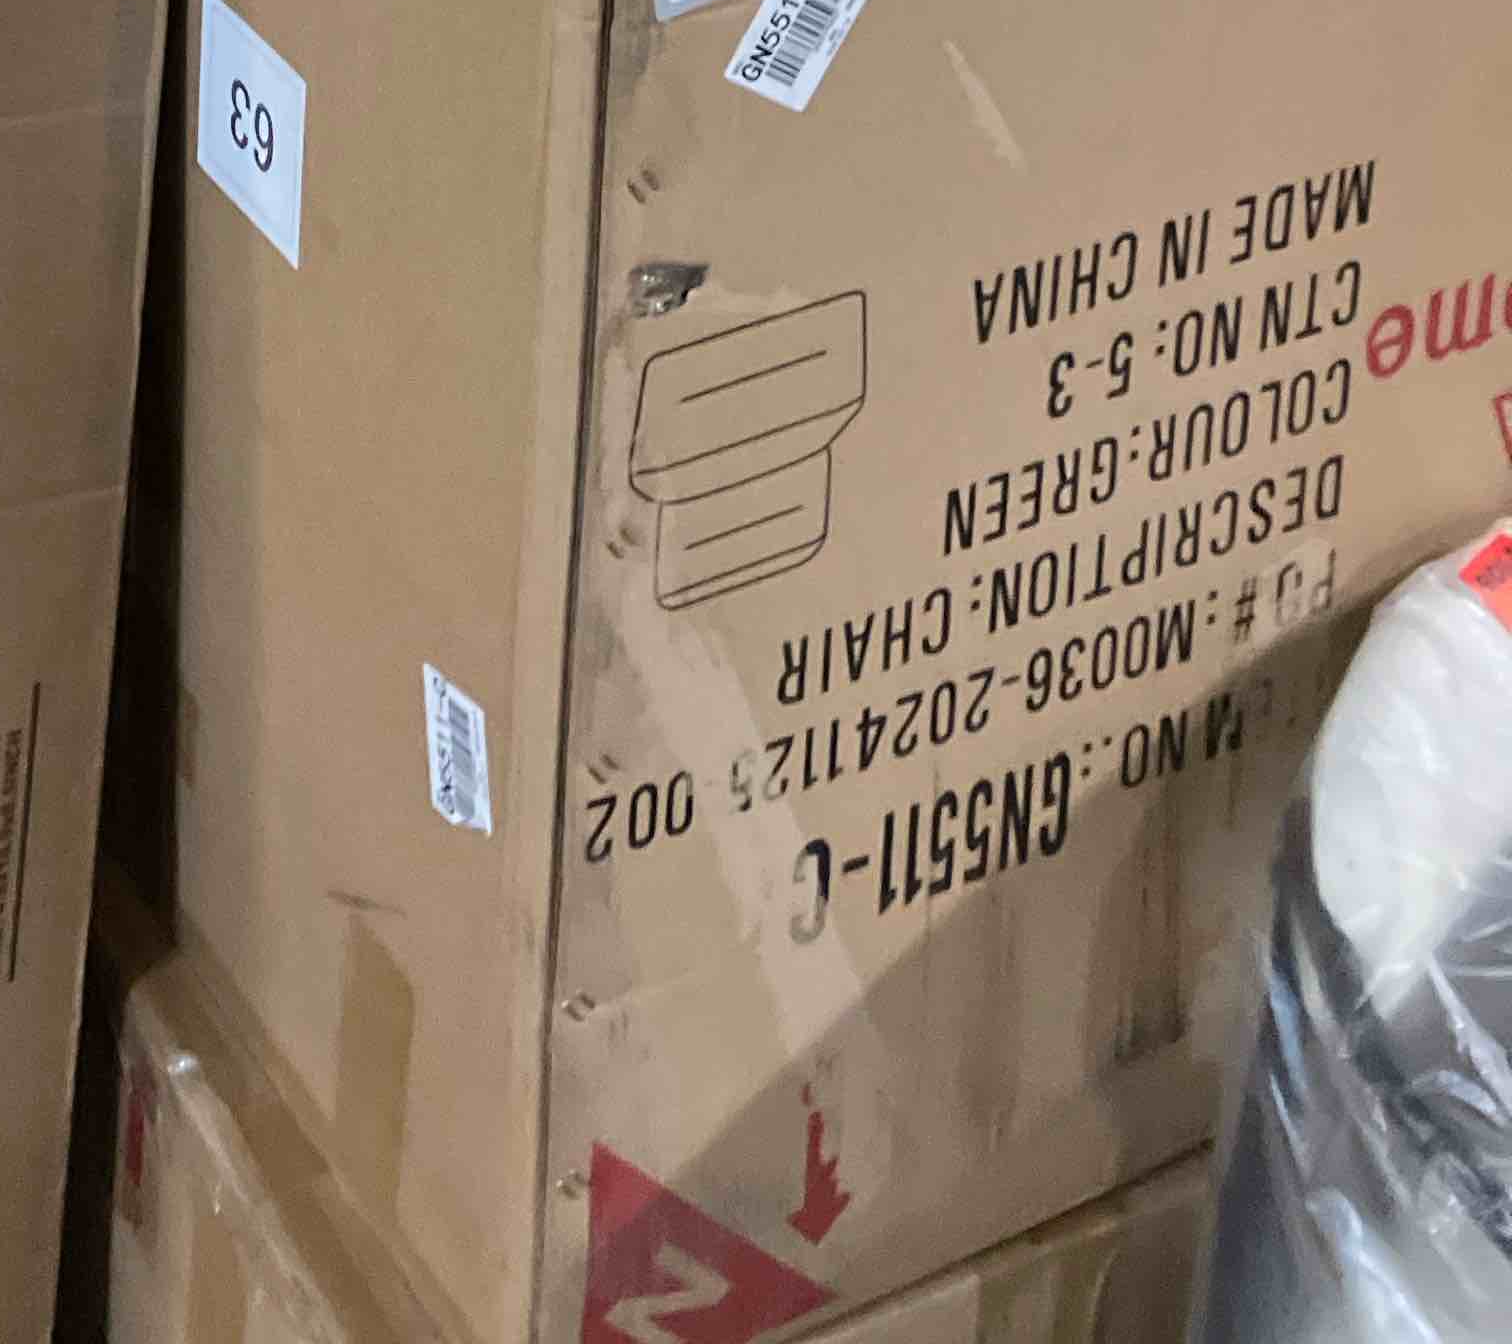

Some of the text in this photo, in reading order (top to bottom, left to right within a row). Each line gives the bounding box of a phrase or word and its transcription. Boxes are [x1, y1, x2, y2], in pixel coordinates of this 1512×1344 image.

[972, 158, 1377, 345] MADE IN CHINA
[1366, 272, 1512, 380] me
[1047, 259, 1364, 421] CTN NO: 5-3
[777, 453, 1345, 706] DESCRIPTION: CHAIR
